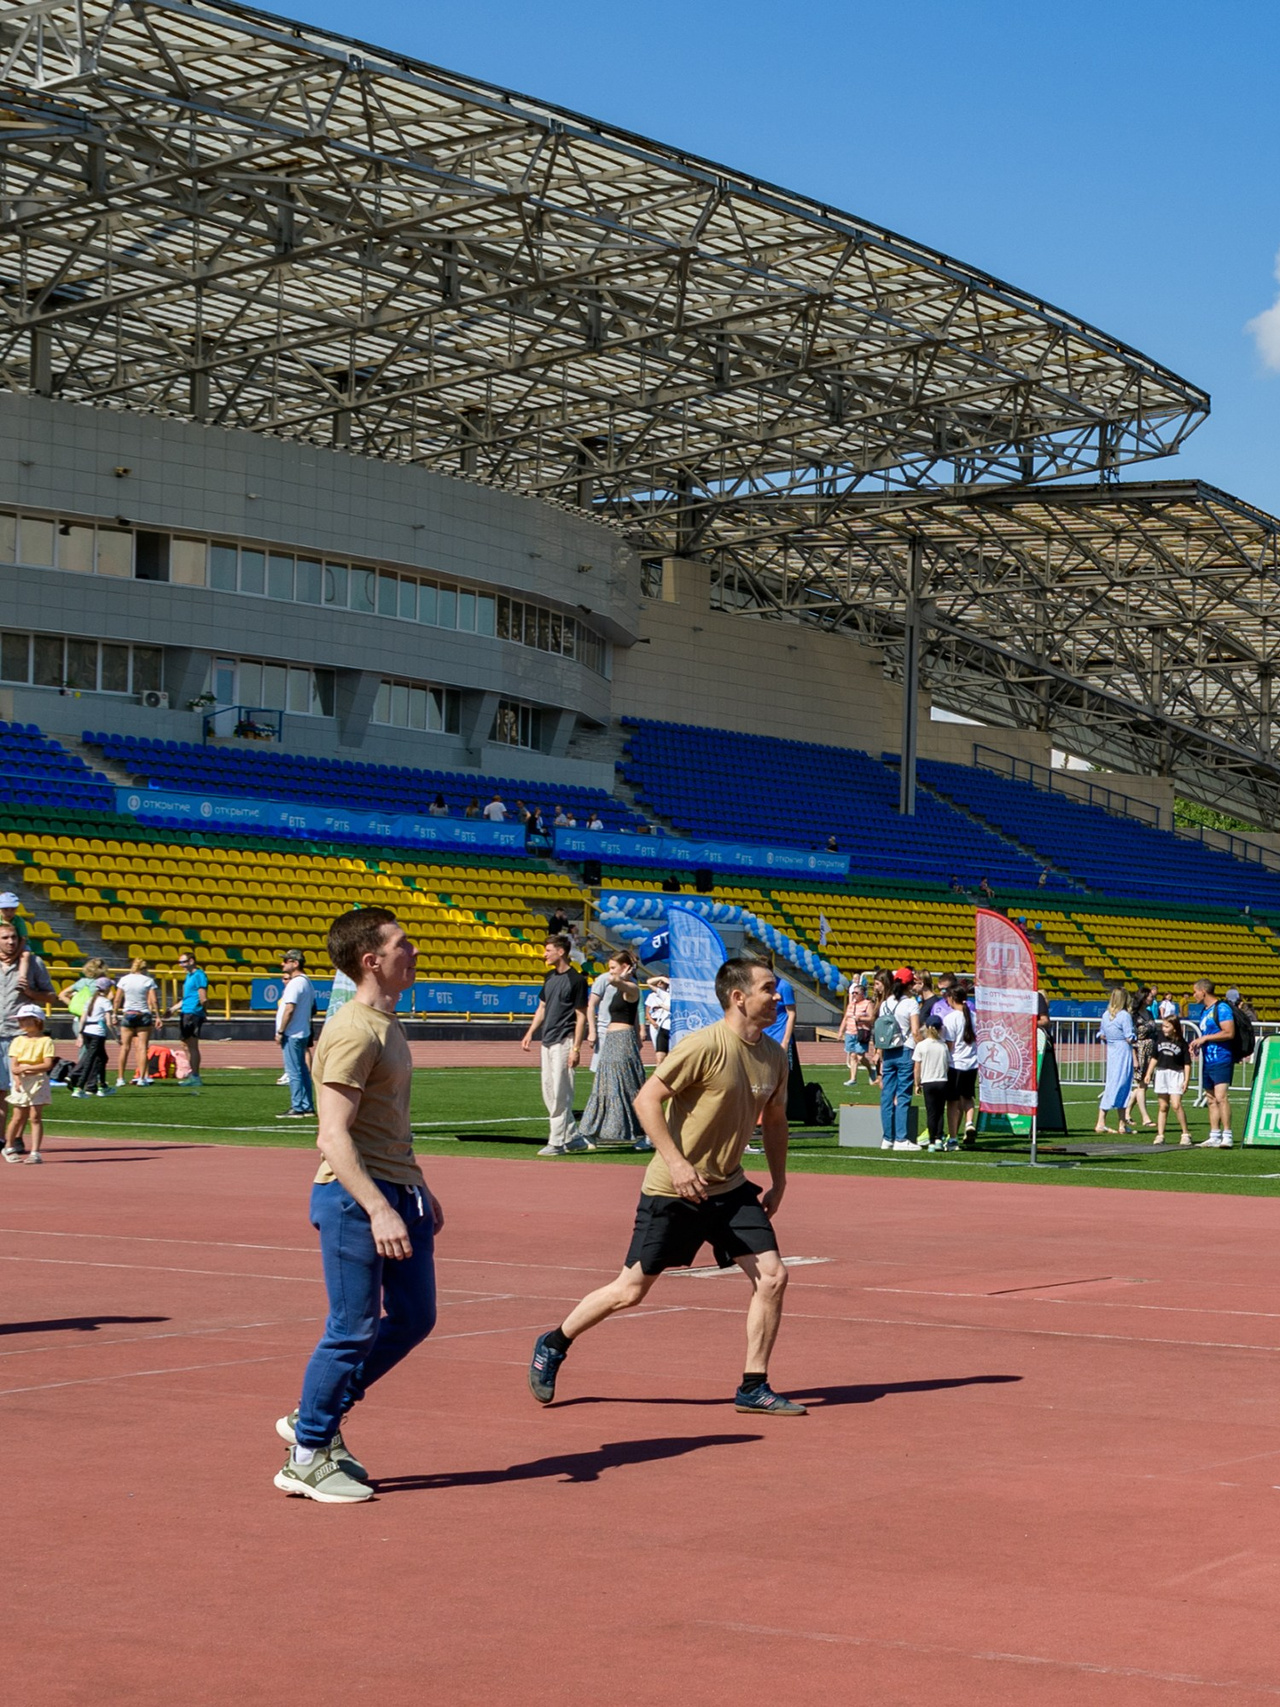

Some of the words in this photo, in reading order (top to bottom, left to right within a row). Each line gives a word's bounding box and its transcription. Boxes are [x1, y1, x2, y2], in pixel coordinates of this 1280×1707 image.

[143, 800, 190, 812] открытие
[214, 806, 260, 818] открытие
[288, 816, 306, 828] ВТБ
[334, 820, 349, 832] ВТБ
[377, 824, 391, 835] ВТБ
[420, 828, 436, 839] ВТБ
[461, 831, 476, 842] ВТБ
[500, 834, 515, 844] ВТБ
[572, 840, 585, 851] ВТБ
[607, 844, 620, 854] ВТБ
[641, 846, 656, 857] ВТБ
[436, 992, 453, 1004] ВТБ
[482, 994, 499, 1006] ВТБ
[527, 995, 539, 1006] ВТ
